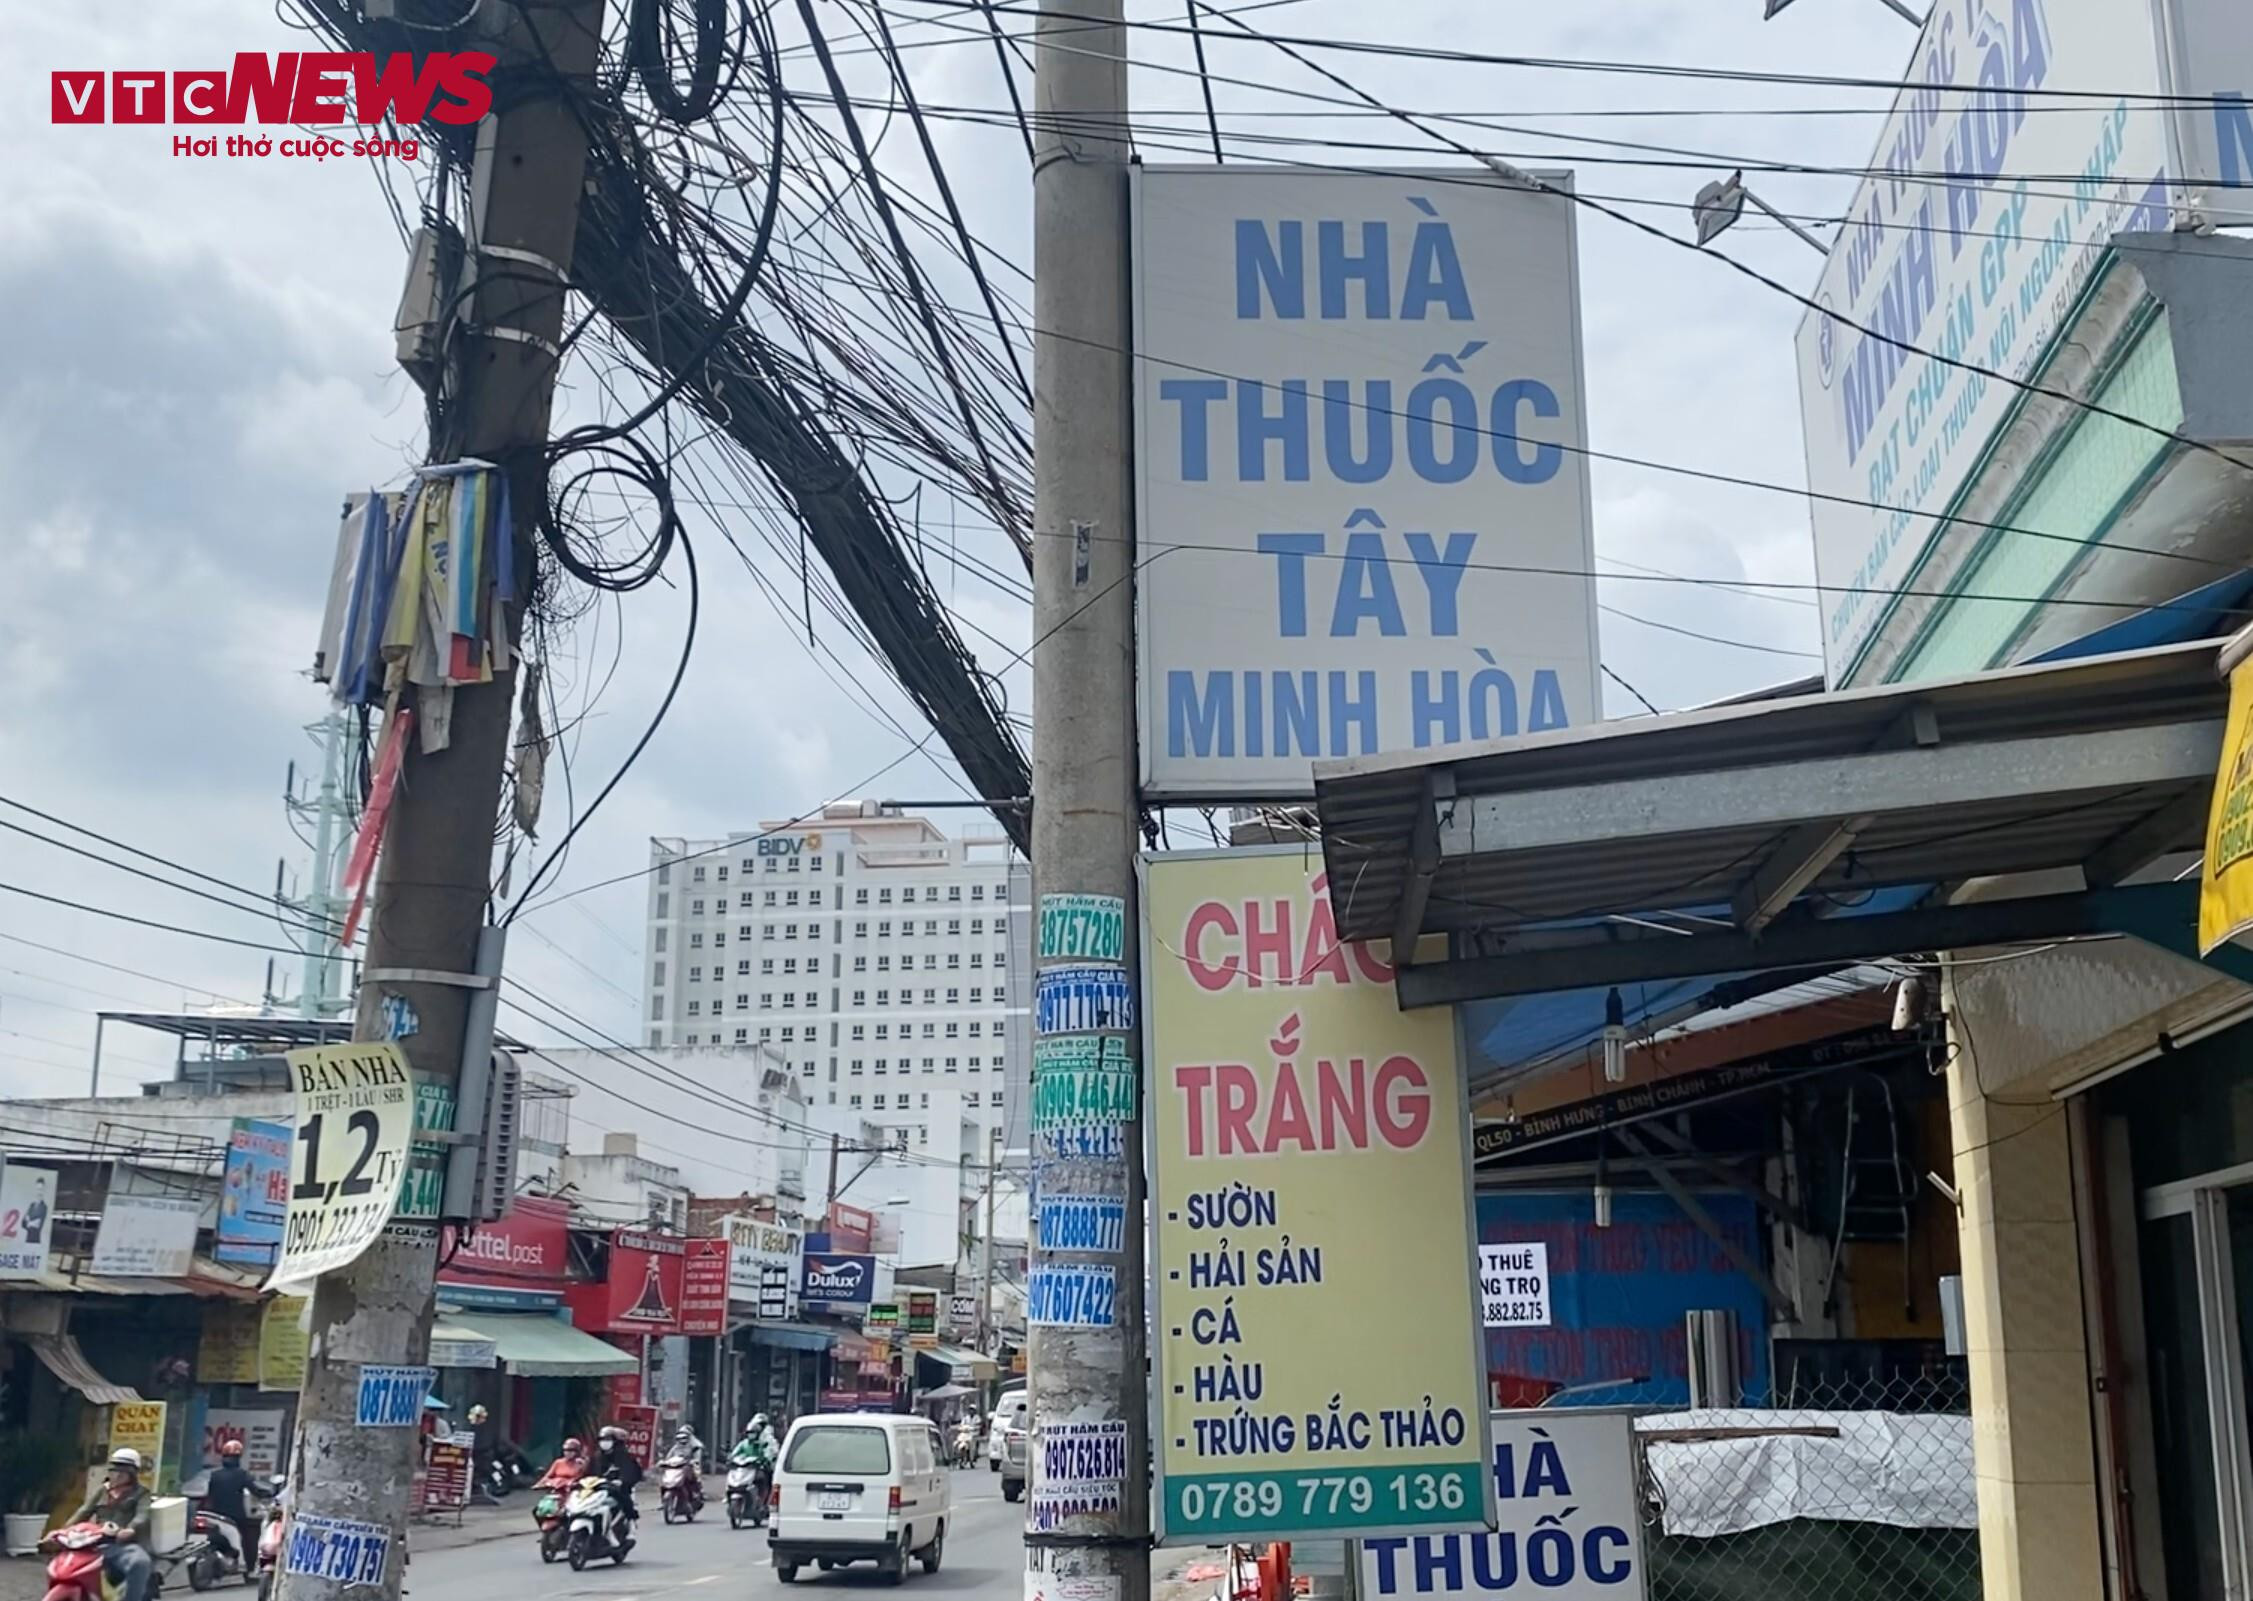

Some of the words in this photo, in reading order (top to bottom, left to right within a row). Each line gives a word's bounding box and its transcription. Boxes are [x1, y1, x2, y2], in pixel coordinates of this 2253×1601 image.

[1235, 196, 1475, 320] NHÀ
[1980, 177, 2028, 307] GPP
[1841, 196, 1935, 468] MINH
[1160, 341, 1563, 483] THUỐC
[1257, 509, 1478, 637] TÂY
[1168, 671, 1379, 758] MINH
[1411, 648, 1570, 748] HÒA
[758, 838, 804, 856] BIDV
[299, 1054, 348, 1093] BÁN
[351, 1047, 407, 1087] NHÀ
[1176, 1013, 1431, 1156] TRẮNG
[293, 1109, 380, 1205] 1,2
[1187, 1182, 1276, 1229] SƯỜN
[512, 1244, 543, 1264] post
[1190, 1237, 1246, 1288] HẢI
[1256, 1235, 1321, 1285] SẢN
[1488, 1249, 1533, 1271] THUÊ
[807, 1272, 855, 1288] Dulux
[1506, 1276, 1541, 1299] TRỌ
[1191, 1296, 1242, 1345] CÁ
[1194, 1354, 1263, 1402] HÀU
[1193, 1407, 1295, 1456] TRỨNG
[1306, 1394, 1371, 1451] BẮC
[1380, 1395, 1465, 1448] THẢO
[1045, 1436, 1125, 1481] 0907.626.814
[1181, 1481, 1282, 1521] 0789
[1297, 1476, 1373, 1515] 779
[1389, 1473, 1464, 1511] 136
[1364, 1506, 1631, 1594] THUỐC
